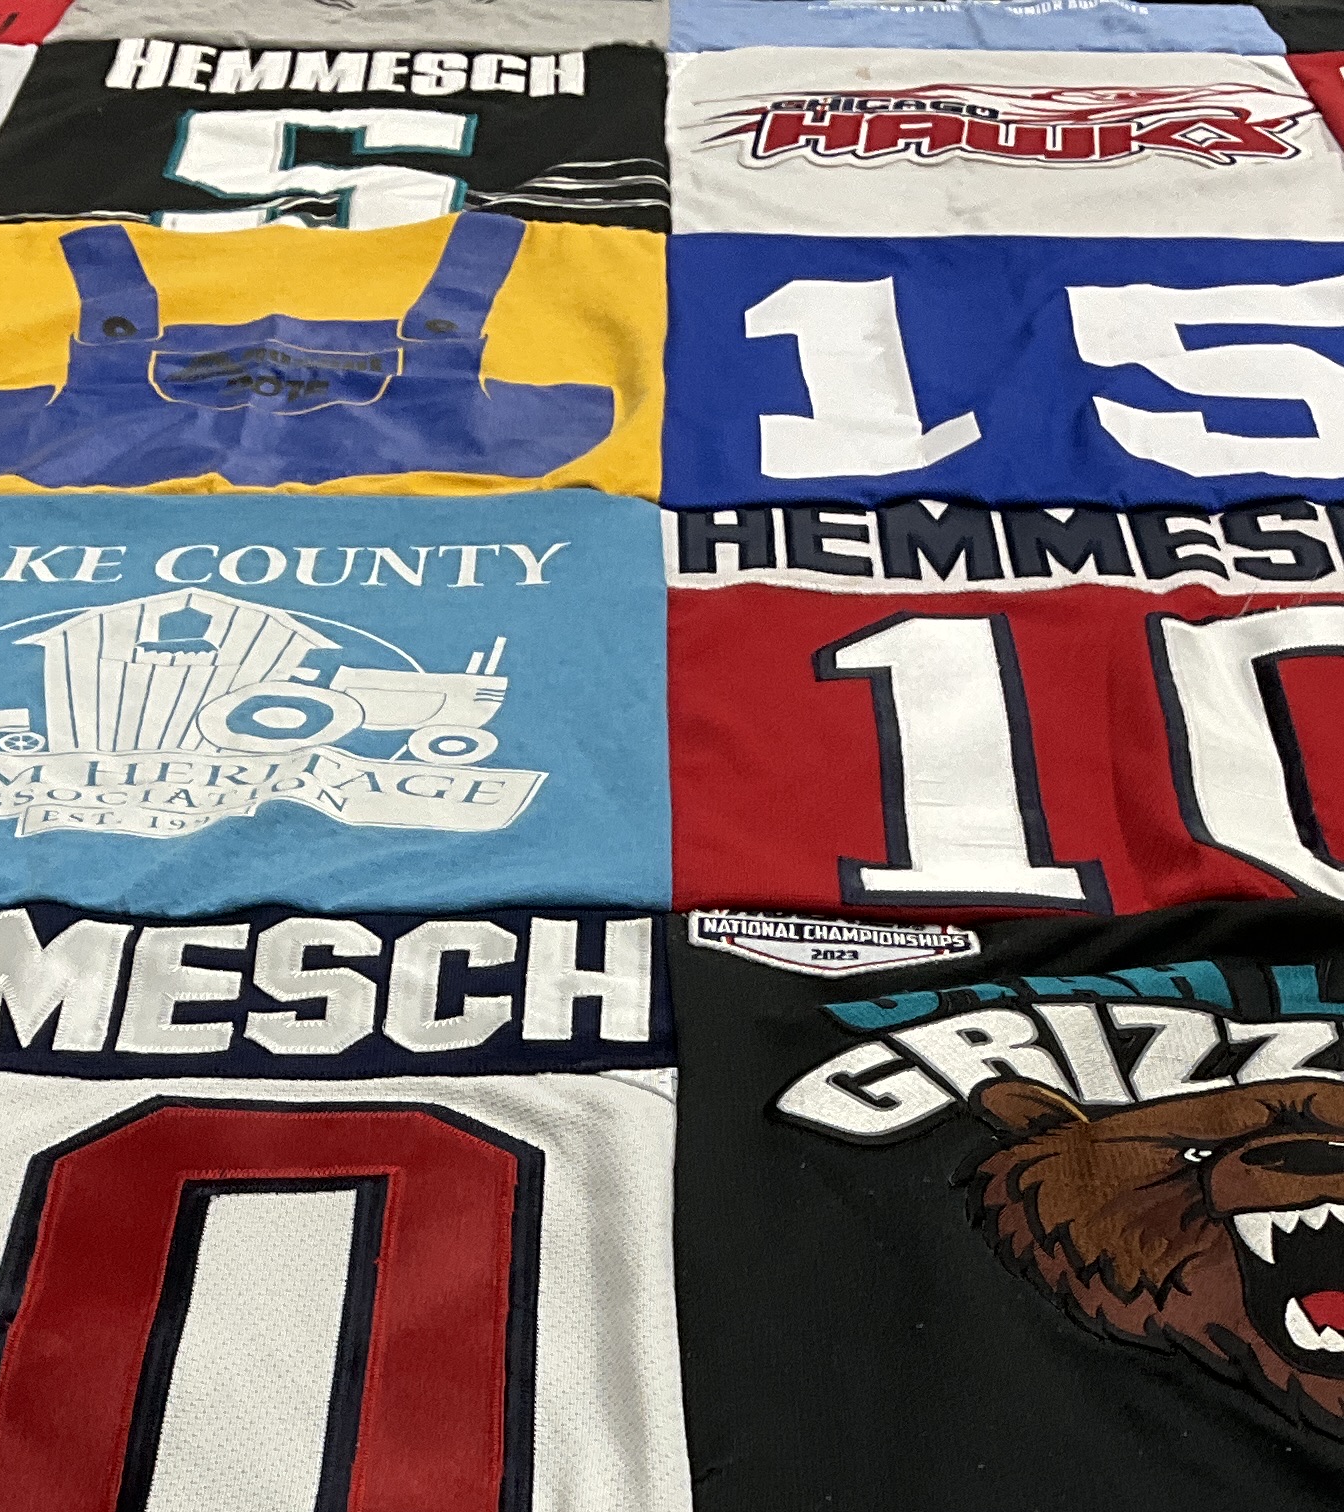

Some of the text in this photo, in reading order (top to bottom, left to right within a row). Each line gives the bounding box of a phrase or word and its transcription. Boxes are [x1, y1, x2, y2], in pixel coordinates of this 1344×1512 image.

[105, 37, 585, 97] HEMMESCH
[770, 97, 999, 119] CHICAGO
[758, 110, 1298, 164] HAWKS
[149, 108, 479, 232] 5
[154, 541, 571, 587] COUNTY
[84, 750, 510, 808] HERITAGE
[703, 917, 965, 948] NATIONAL CHAMPIONSHIPS
[811, 949, 858, 961] 2023
